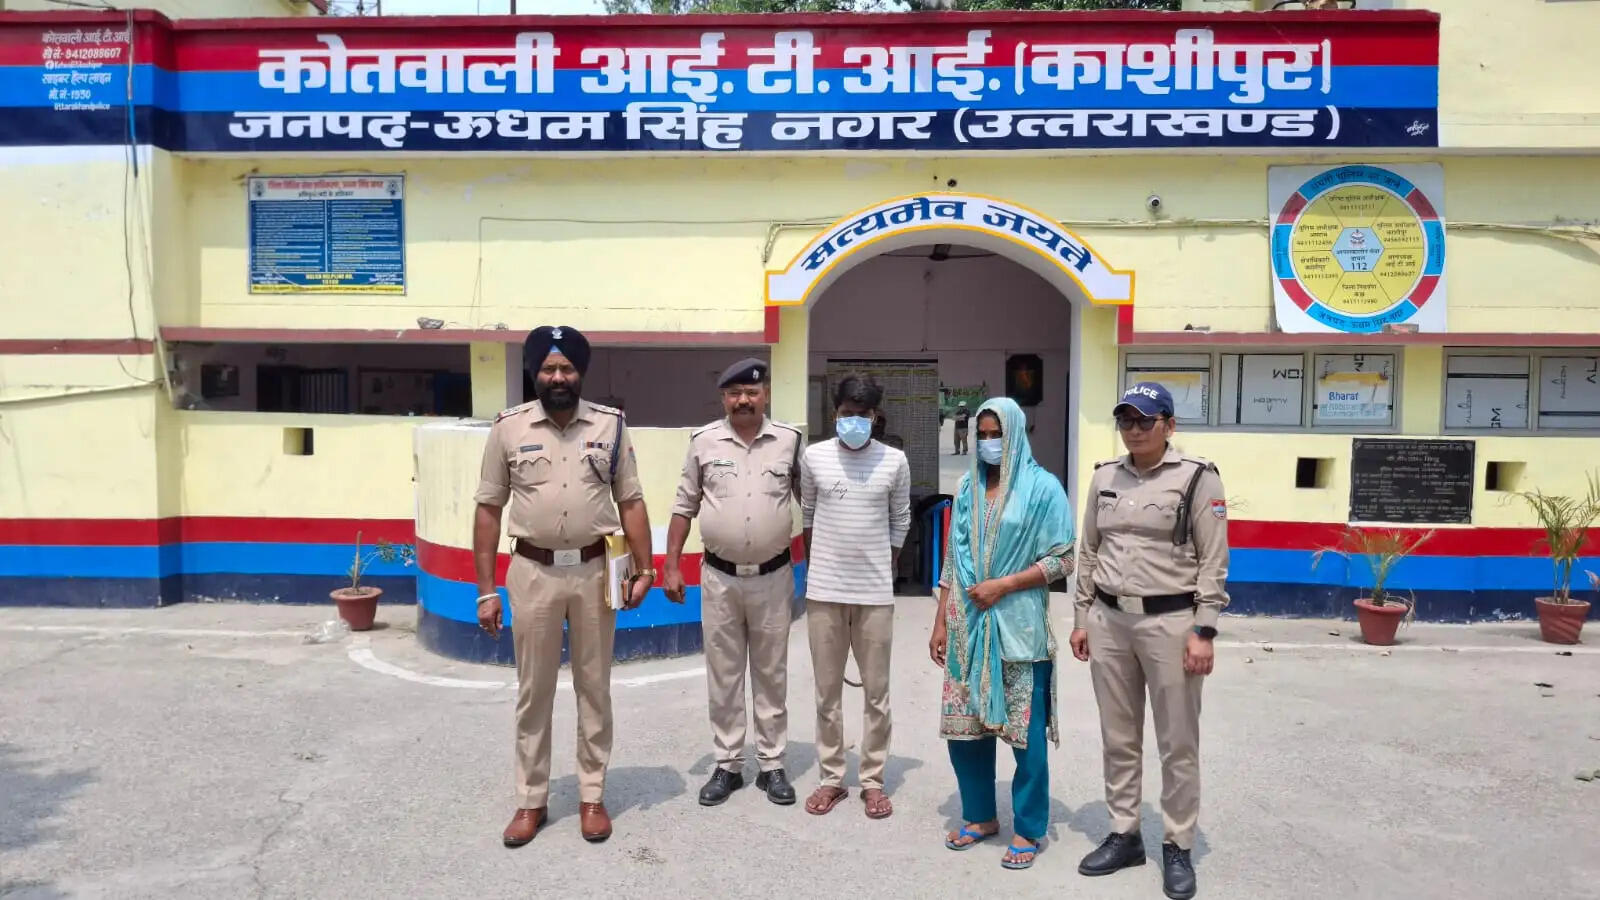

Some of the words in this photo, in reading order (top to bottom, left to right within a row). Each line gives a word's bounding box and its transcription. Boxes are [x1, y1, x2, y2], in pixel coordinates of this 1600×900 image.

[257, 33, 561, 94] कोतवाली
[580, 32, 735, 103] आई.
[747, 32, 830, 93] टी.
[843, 30, 1001, 101] आई.
[1015, 28, 1331, 104] (काशीपुर)
[622, 101, 748, 148] सिंह
[771, 111, 937, 141] नगर
[953, 106, 1340, 143] (उत्तराखण्ड)
[800, 197, 967, 271] सत्यमेव
[983, 204, 1093, 273] जयते
[1350, 262, 1368, 271] 112
[1123, 386, 1158, 400] POLICE
[1328, 391, 1359, 401] Bharat
